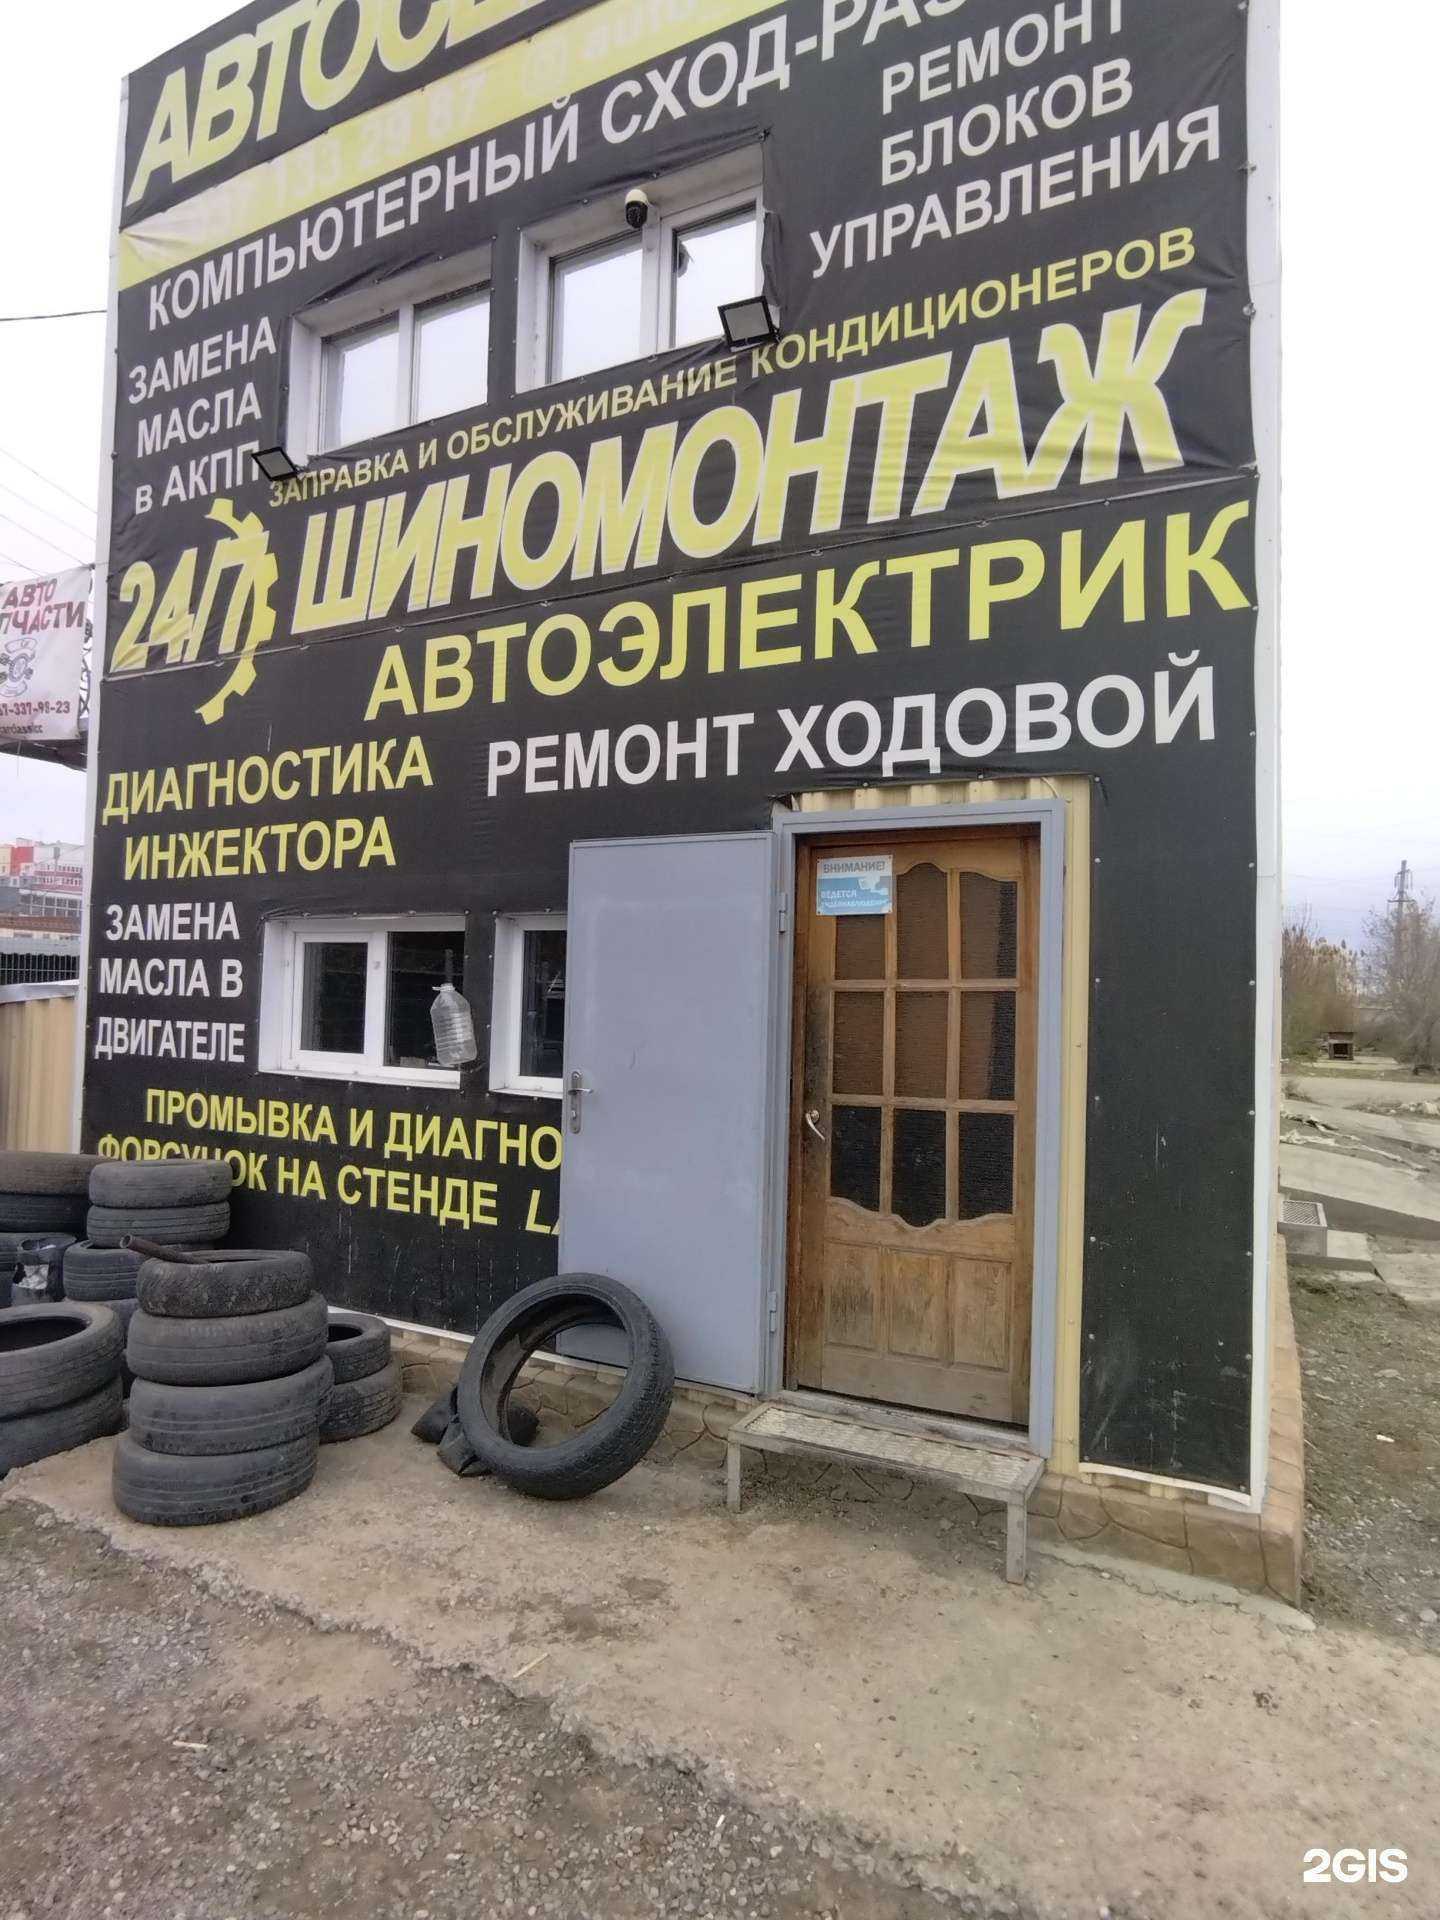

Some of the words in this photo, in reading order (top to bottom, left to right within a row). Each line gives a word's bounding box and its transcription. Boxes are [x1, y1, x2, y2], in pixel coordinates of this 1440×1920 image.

[881, 58, 1133, 186] БЛОКОВ
[148, 93, 579, 332] КОМПЬЮТЕРНЫЙ
[601, 0, 968, 145] СХОД-РА
[810, 105, 1220, 279] УПРАВЛЕНИЯ
[128, 316, 276, 404] ЗАМЕНА
[269, 448, 409, 508] ЗАПРАВКА
[418, 437, 438, 469] И
[446, 355, 737, 460] ОБСЛУЖИВАНИЕ
[751, 227, 1196, 378] КОНДИЦИОНЕРОВ
[137, 382, 262, 458] МАСЛА
[162, 441, 260, 507] АКПП
[290, 288, 1207, 636] ШИНОМОНТАЖ
[2, 578, 57, 609] АВТО
[364, 500, 1251, 721] АВТОЭЛЕКТРИК
[487, 713, 754, 797] РЕМОНТ
[774, 649, 1216, 777] ХОДОВОЙ
[102, 735, 433, 825] ДИАГНОСТИКА
[124, 816, 396, 880] ИНЖЕКТОРА
[105, 901, 240, 941] ЗАМЕНА
[100, 958, 210, 997] МАСЛА
[220, 959, 243, 998] В
[94, 1016, 245, 1063] ДВИГАТЕЛЕ
[146, 1088, 337, 1145] ПРОМЫВКА
[349, 1108, 374, 1149] И
[384, 1112, 562, 1170] ДИАГНО
[277, 1156, 326, 1200] НА
[337, 1165, 498, 1229] СТЕНДЕ
[525, 1189, 560, 1235] L
